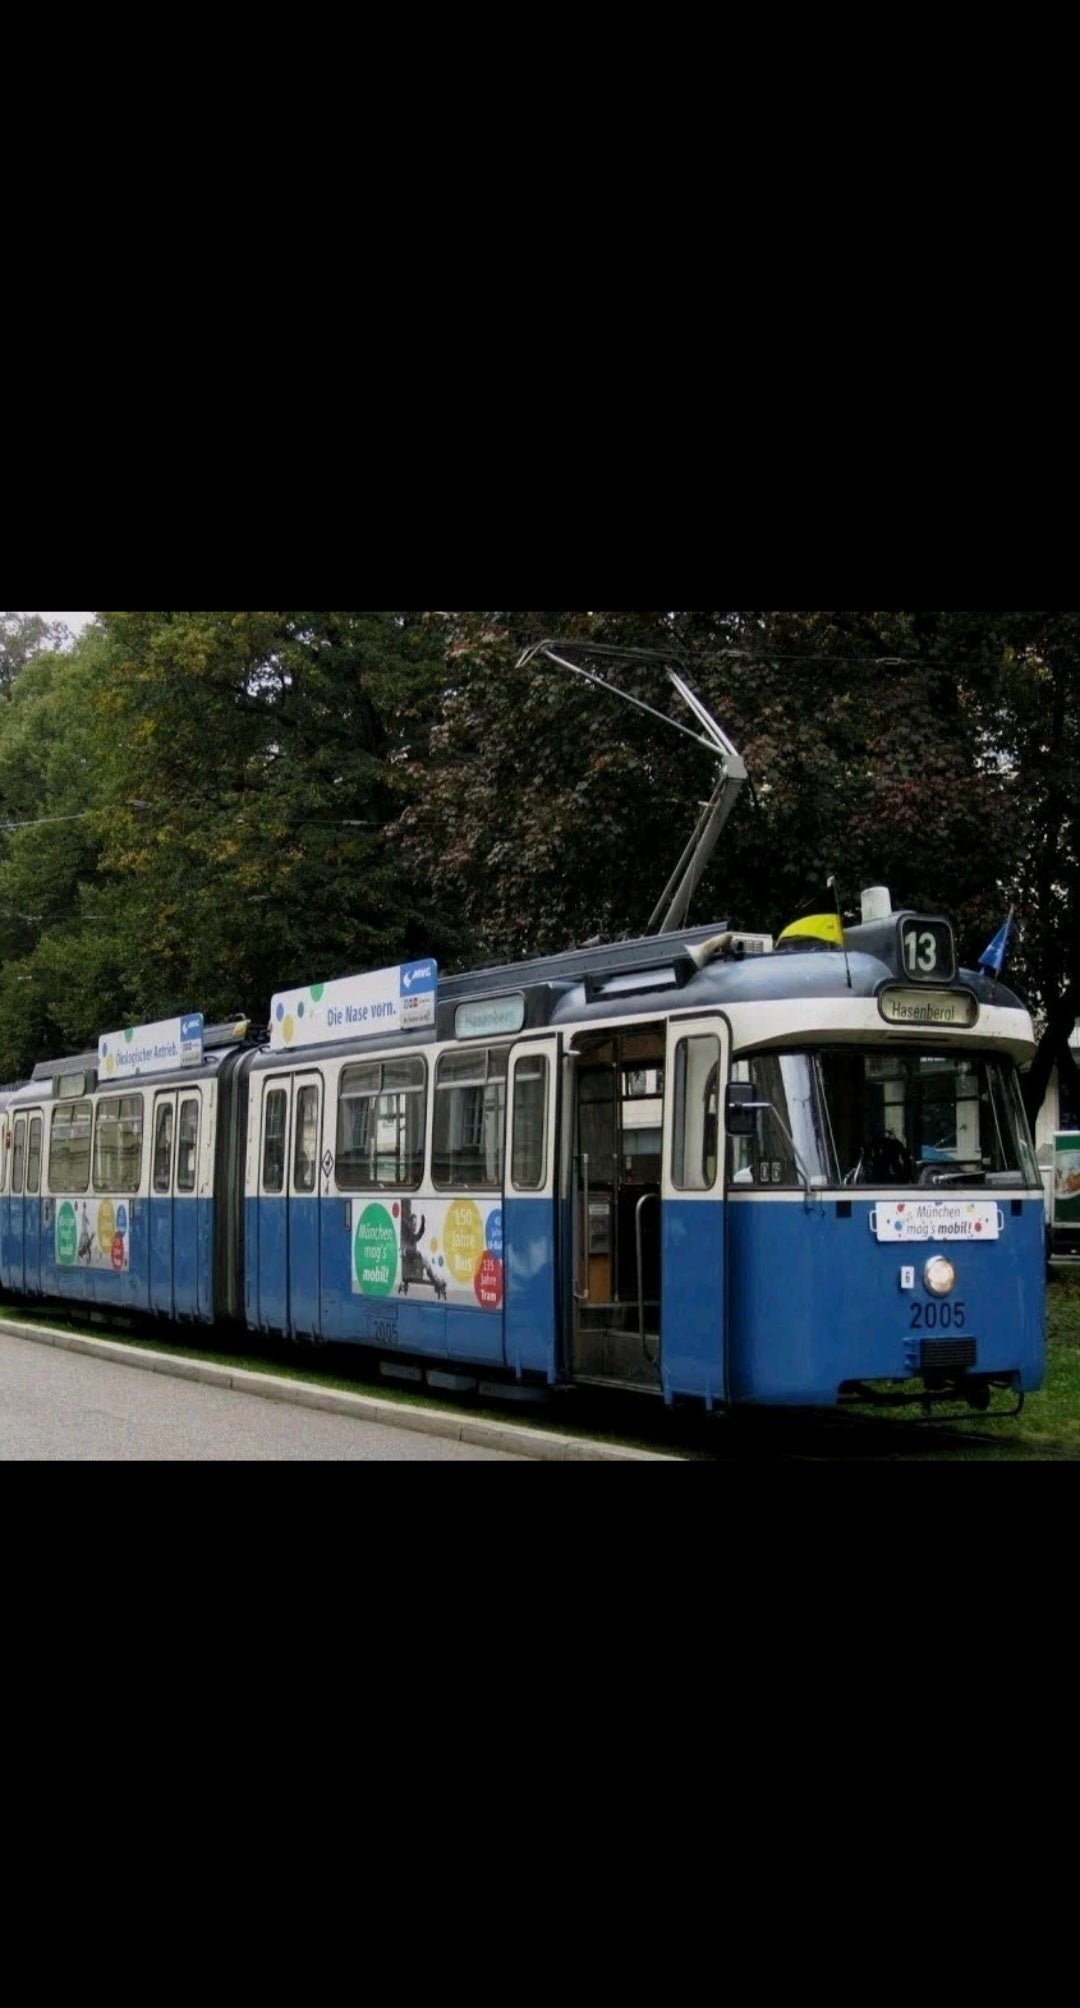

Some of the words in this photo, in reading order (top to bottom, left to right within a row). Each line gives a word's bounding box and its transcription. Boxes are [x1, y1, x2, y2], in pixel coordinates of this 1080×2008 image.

[904, 931, 937, 972] 13
[327, 1008, 343, 1027] Die
[345, 1004, 369, 1023] Nase
[371, 1000, 397, 1019] vorn.
[917, 1206, 961, 1219] München
[358, 1223, 394, 1242] München
[906, 1221, 936, 1238] mag's
[937, 1221, 973, 1235] mobil!
[452, 1231, 475, 1250] Jahre
[363, 1245, 387, 1262] mag's
[455, 1255, 473, 1274] Bus
[362, 1267, 390, 1284] mobil!
[481, 1273, 497, 1287] Jahre
[480, 1289, 497, 1303] Tram
[910, 1302, 965, 1329] 2005
